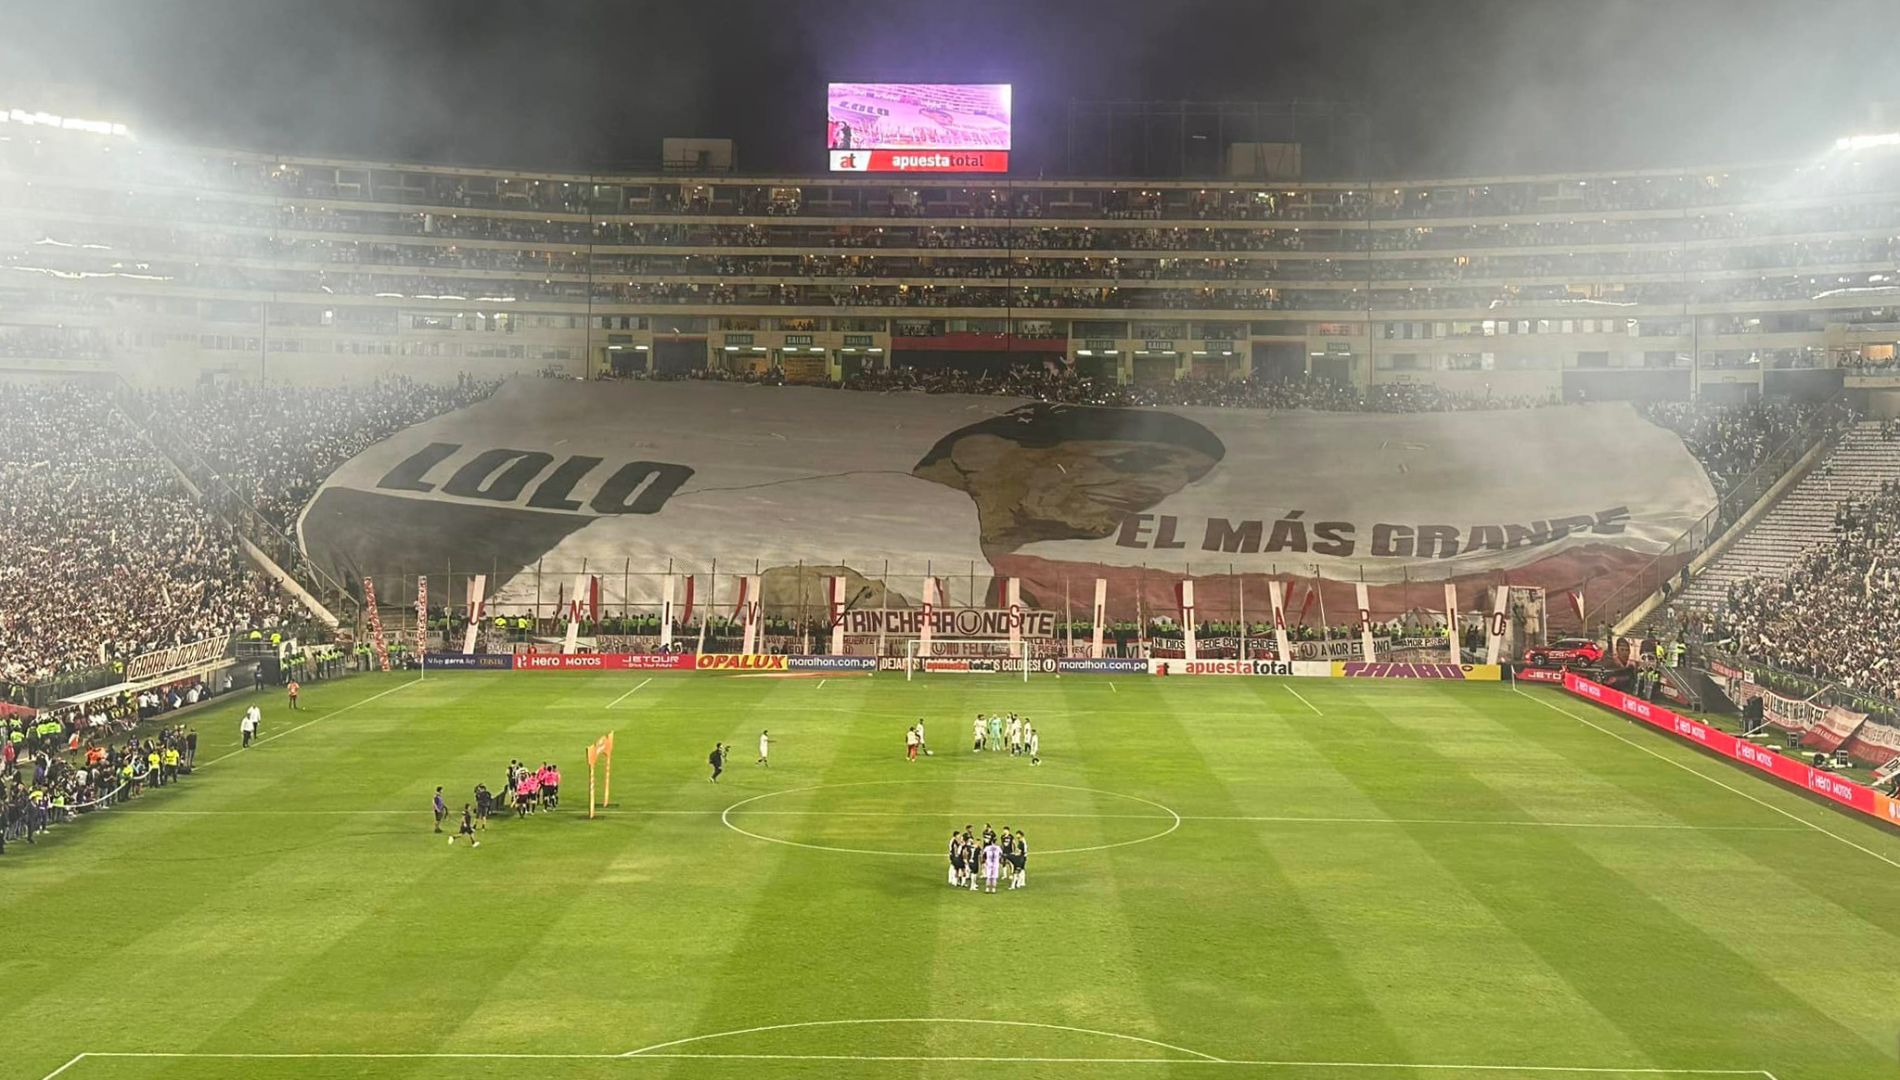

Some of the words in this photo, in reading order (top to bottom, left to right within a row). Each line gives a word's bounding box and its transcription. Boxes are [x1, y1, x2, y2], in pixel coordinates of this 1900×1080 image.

[787, 336, 812, 344] SALIDA
[376, 443, 695, 514] LOLO
[1115, 514, 1185, 549] EL
[1201, 511, 1355, 557] MÁS
[1370, 506, 1631, 558] GRANDE
[1351, 640, 1390, 654] ETRNO
[566, 657, 601, 666] MOTOS
[622, 655, 679, 663] JETOUR
[698, 655, 783, 669] OPALUX
[788, 657, 876, 669] marathon.com.pe
[1059, 660, 1147, 671] marathon.com.pe
[1528, 671, 1561, 679] JETO
